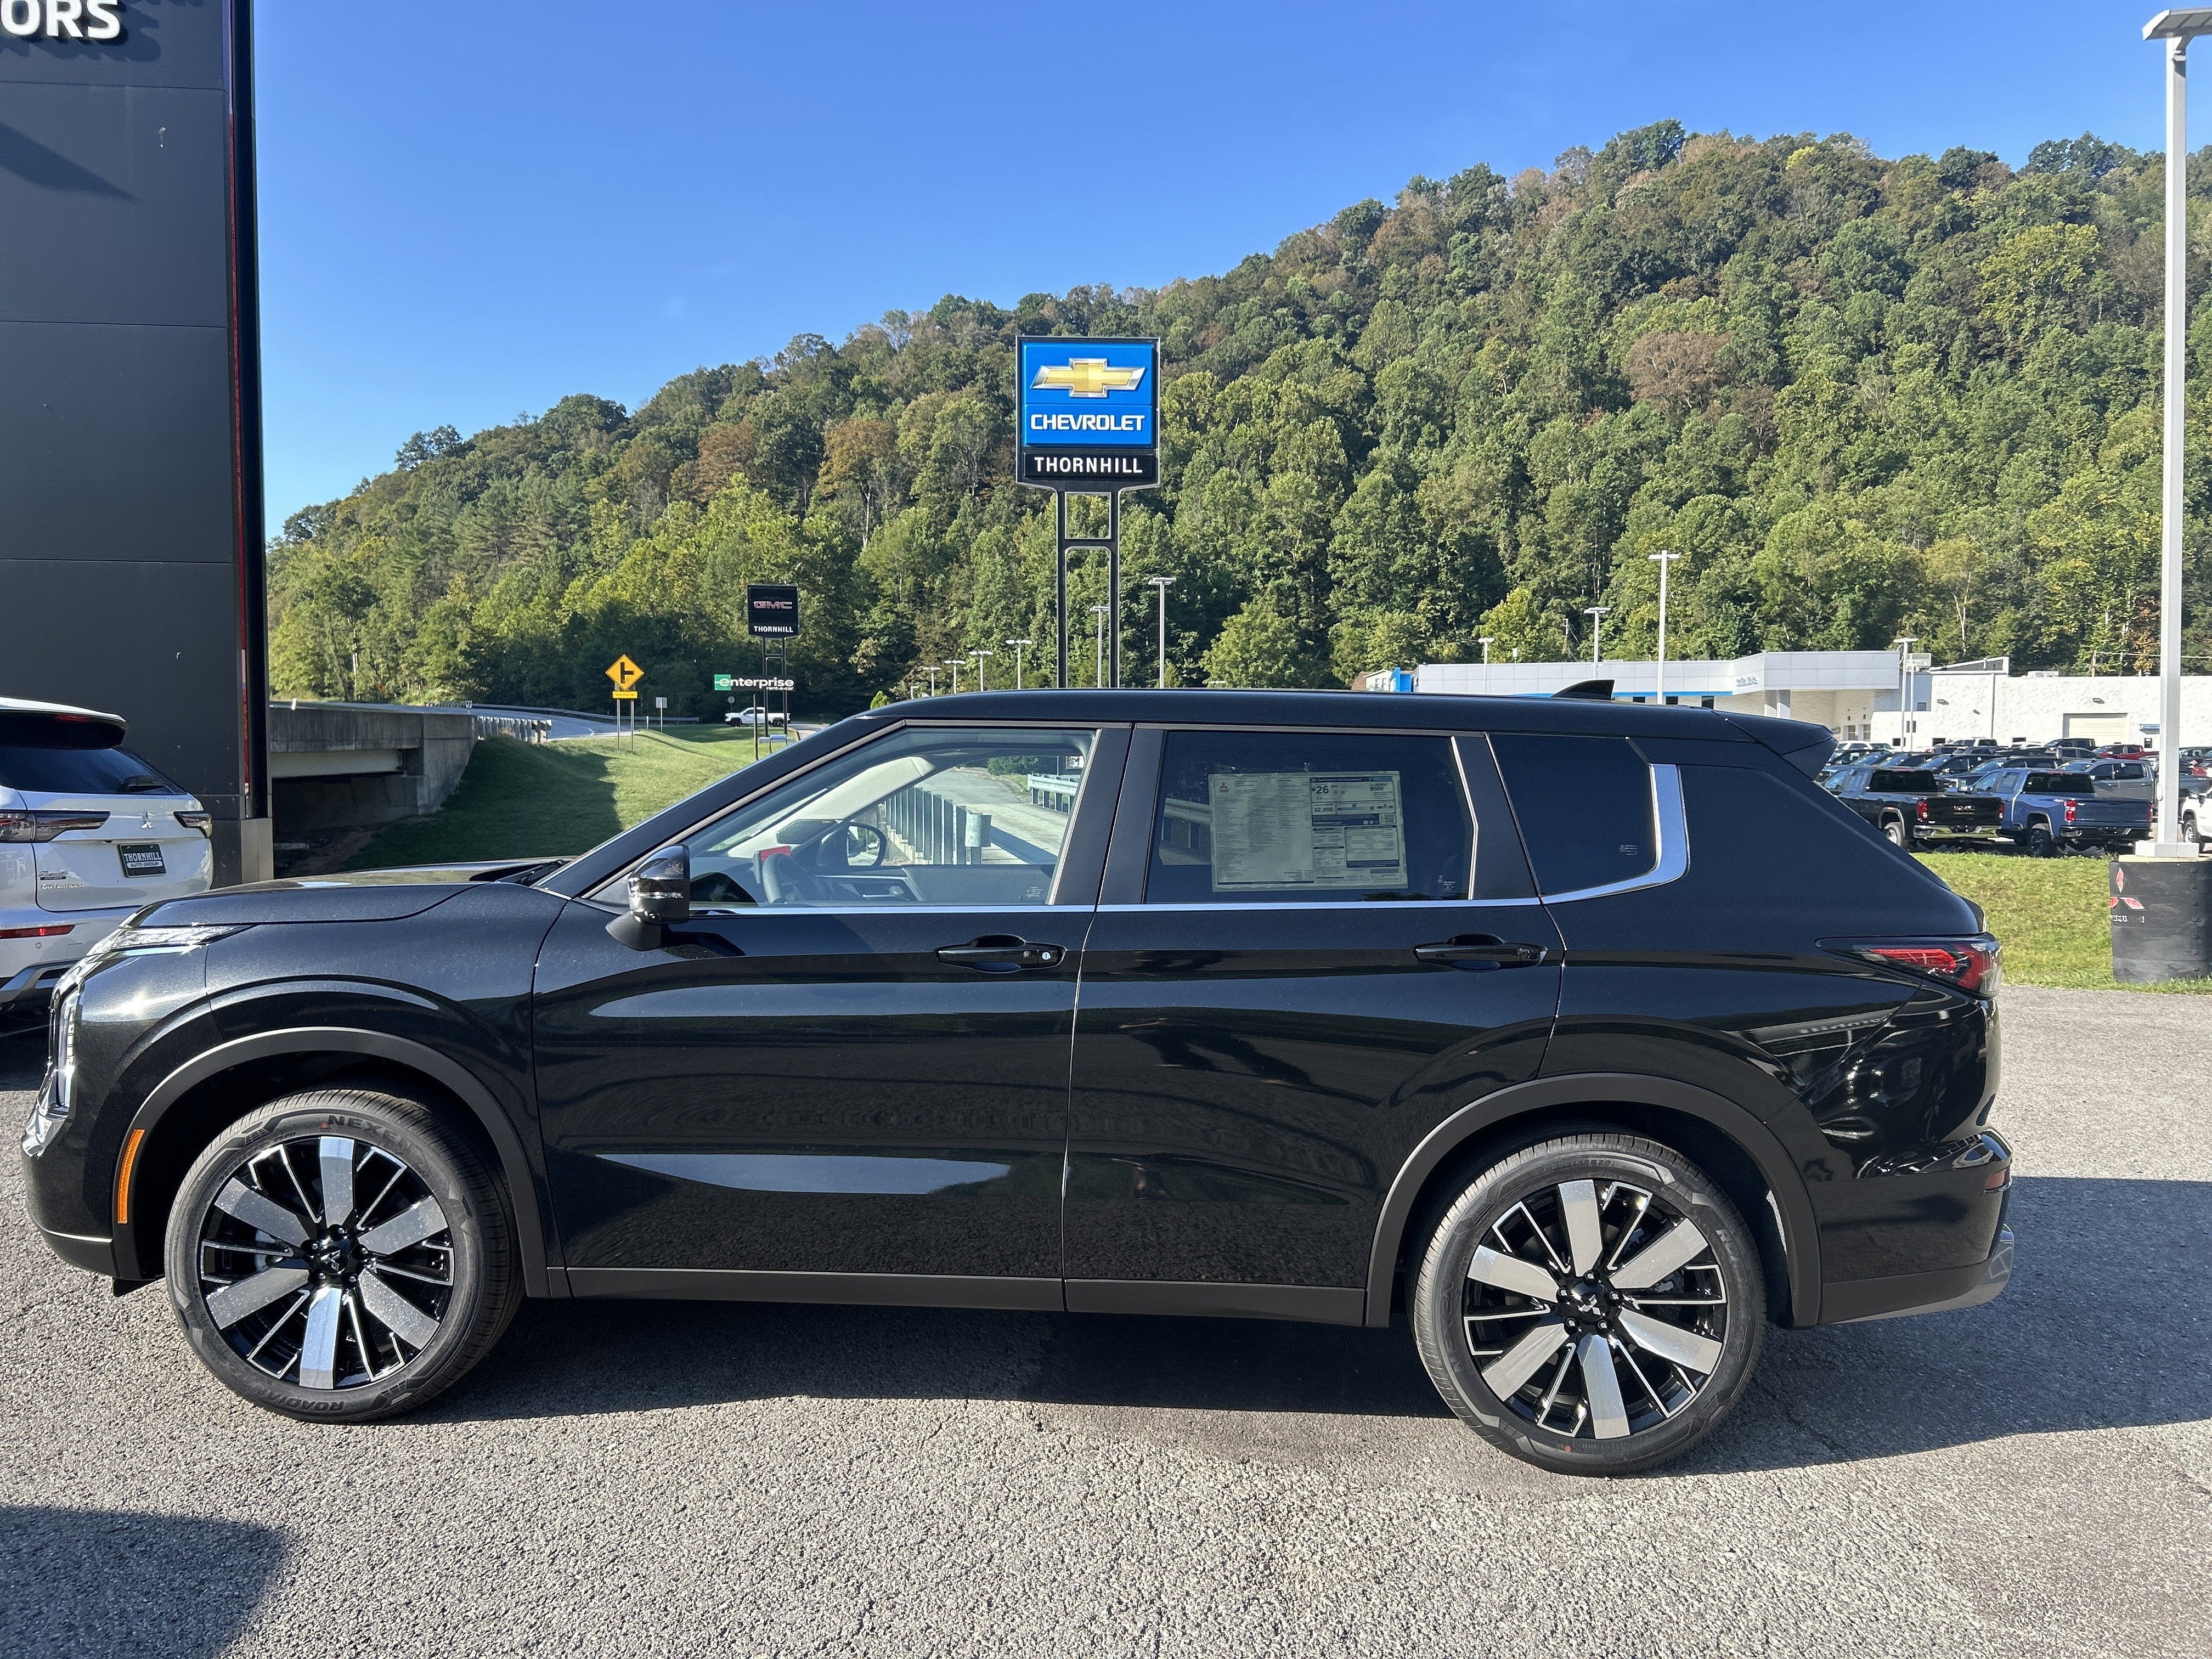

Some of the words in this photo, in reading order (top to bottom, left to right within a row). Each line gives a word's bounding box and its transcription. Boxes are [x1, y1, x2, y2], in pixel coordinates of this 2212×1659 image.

[0, 0, 120, 38] ORS
[1031, 414, 1145, 431] CHEVROLET
[1034, 457, 1143, 473] THORNHILL
[754, 601, 792, 609] GMC
[719, 676, 794, 689] enterprise
[1316, 785, 1329, 794] 26
[124, 852, 161, 862] THORNHILL
